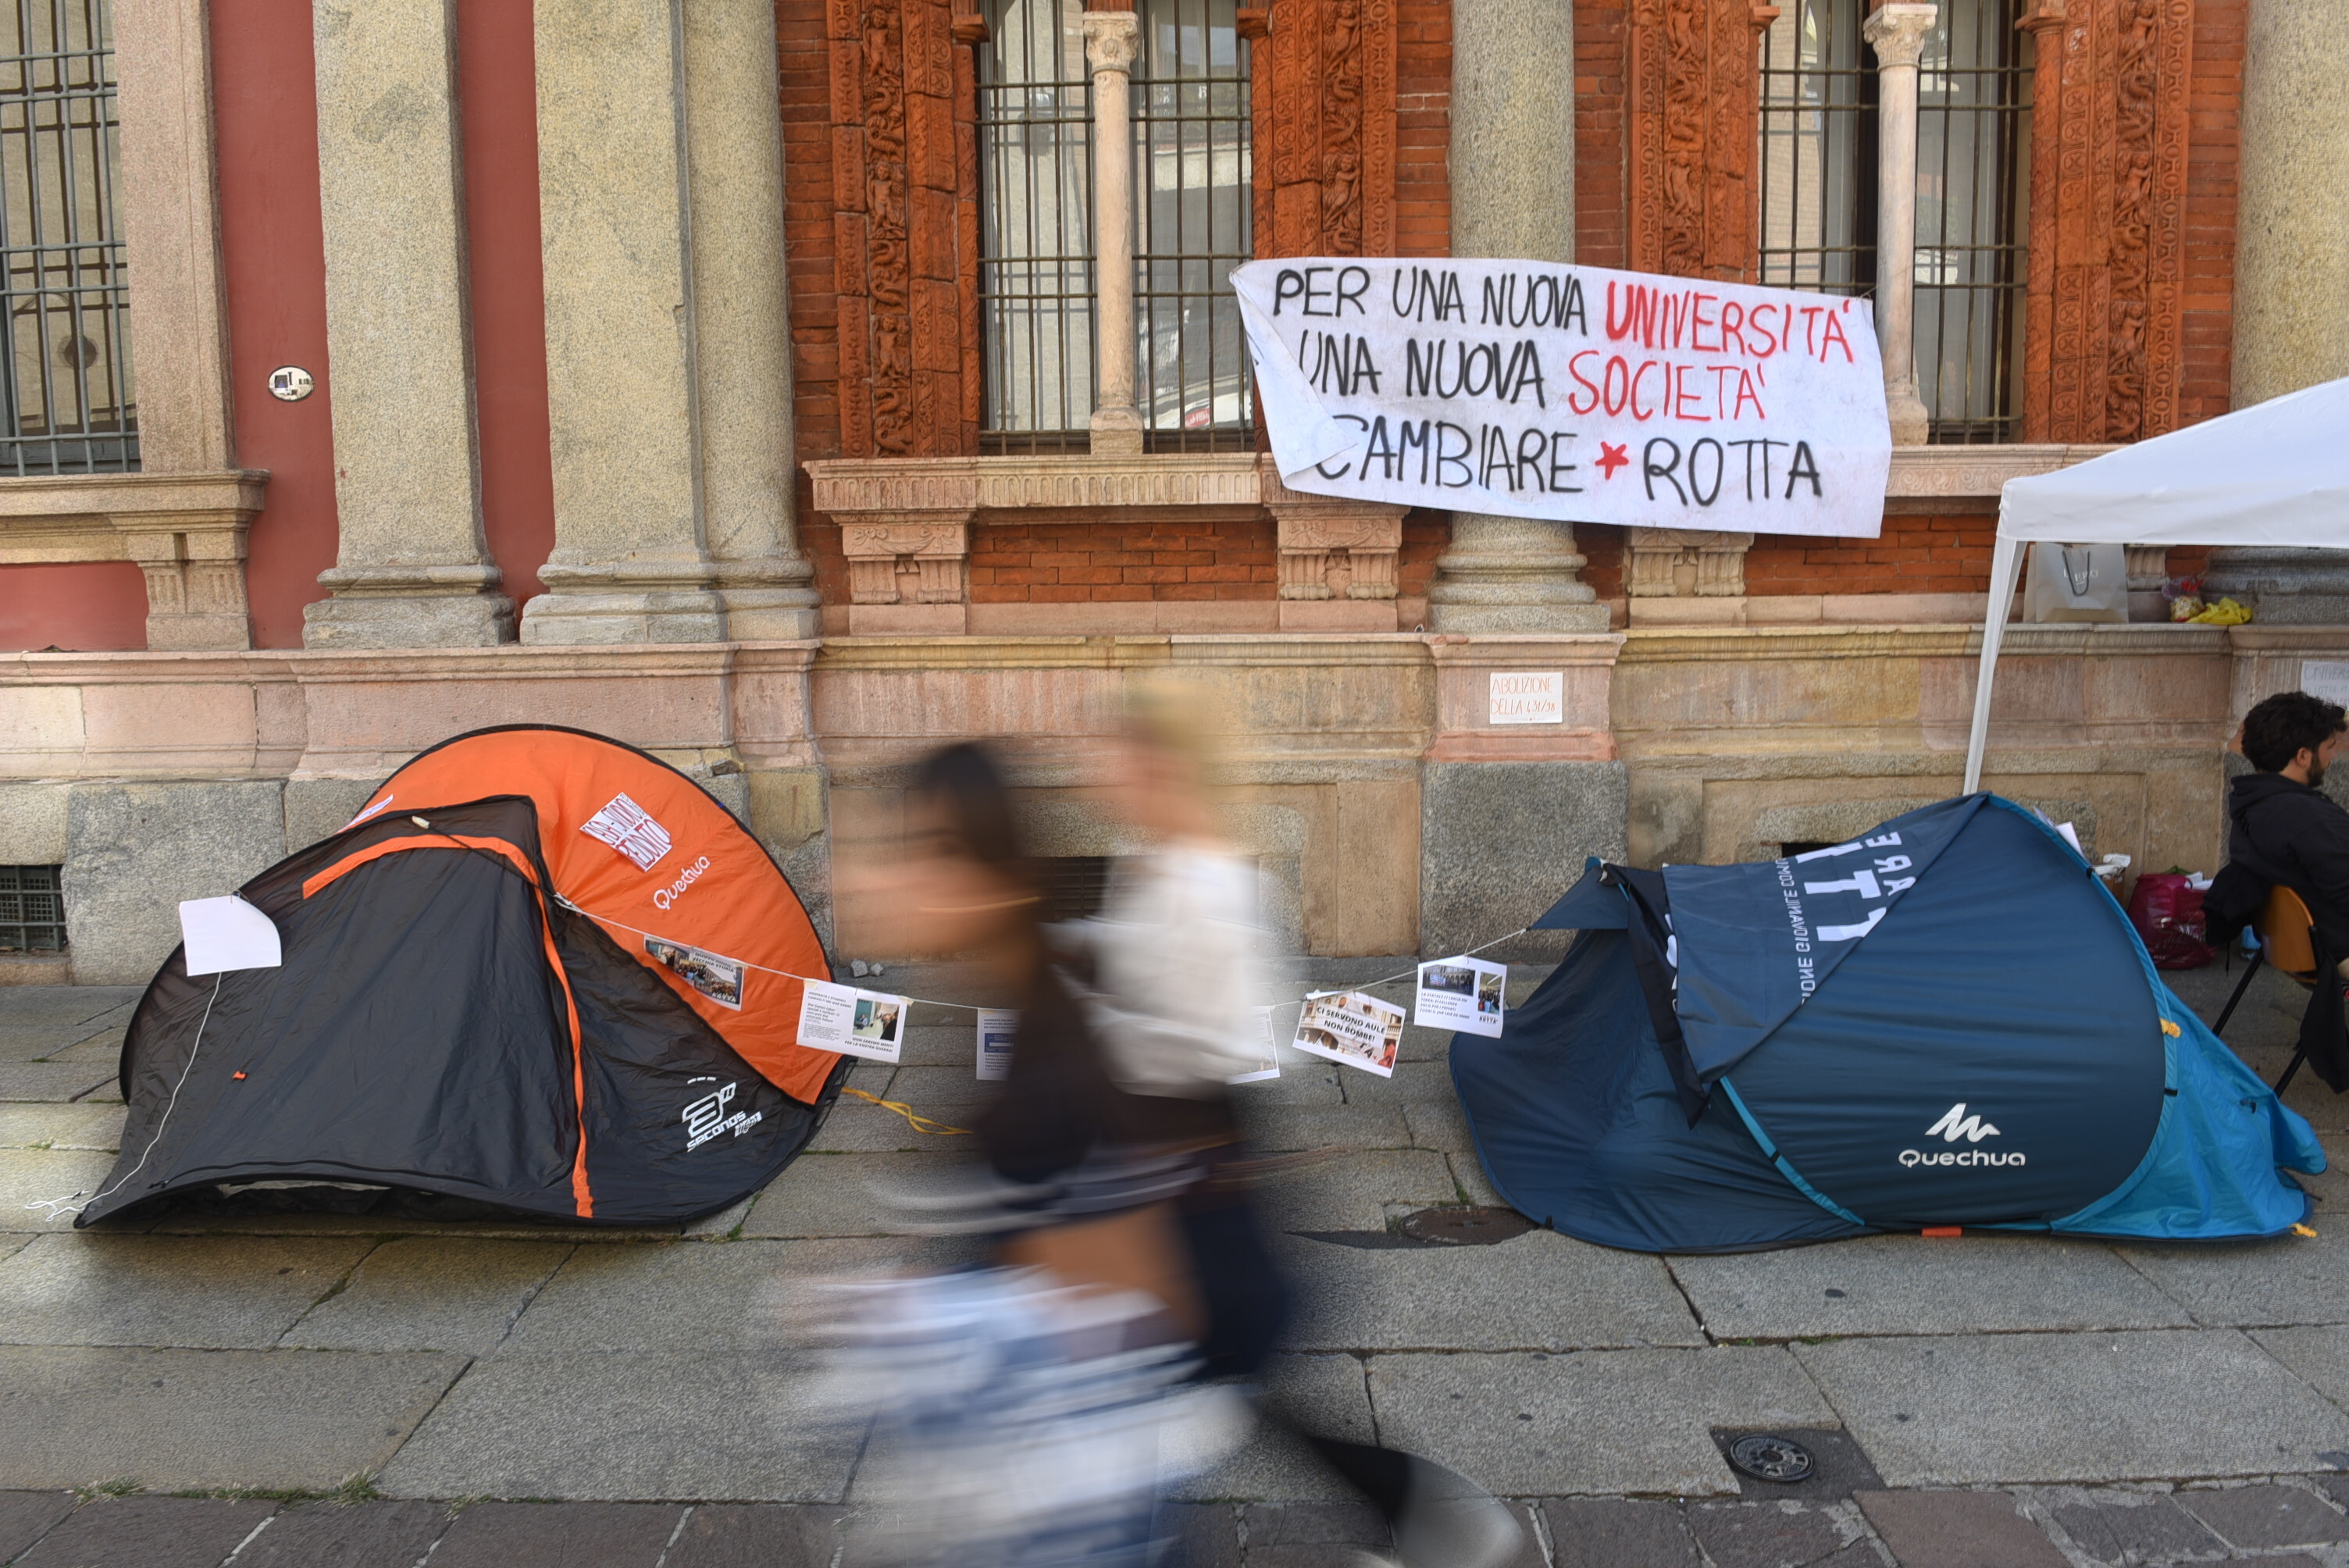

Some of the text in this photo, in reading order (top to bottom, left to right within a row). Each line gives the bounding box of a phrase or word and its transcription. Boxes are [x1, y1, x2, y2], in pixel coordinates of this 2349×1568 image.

[1274, 265, 1371, 318] PER
[1393, 266, 1465, 323] UNA
[1481, 274, 1588, 335] NUOVA
[1299, 330, 1382, 397] UNA
[1406, 339, 1545, 409] NUOVA
[1643, 438, 1822, 507] ROTTA
[1492, 676, 1553, 694] ABOLIZIONE
[1491, 698, 1523, 715] DELLA
[654, 856, 711, 911] Quechua
[1324, 1020, 1375, 1042] NON BOMBE!
[1327, 1009, 1363, 1027] SERVONO
[1365, 1021, 1385, 1035] AULE
[1898, 1148, 2026, 1168] Quechua
